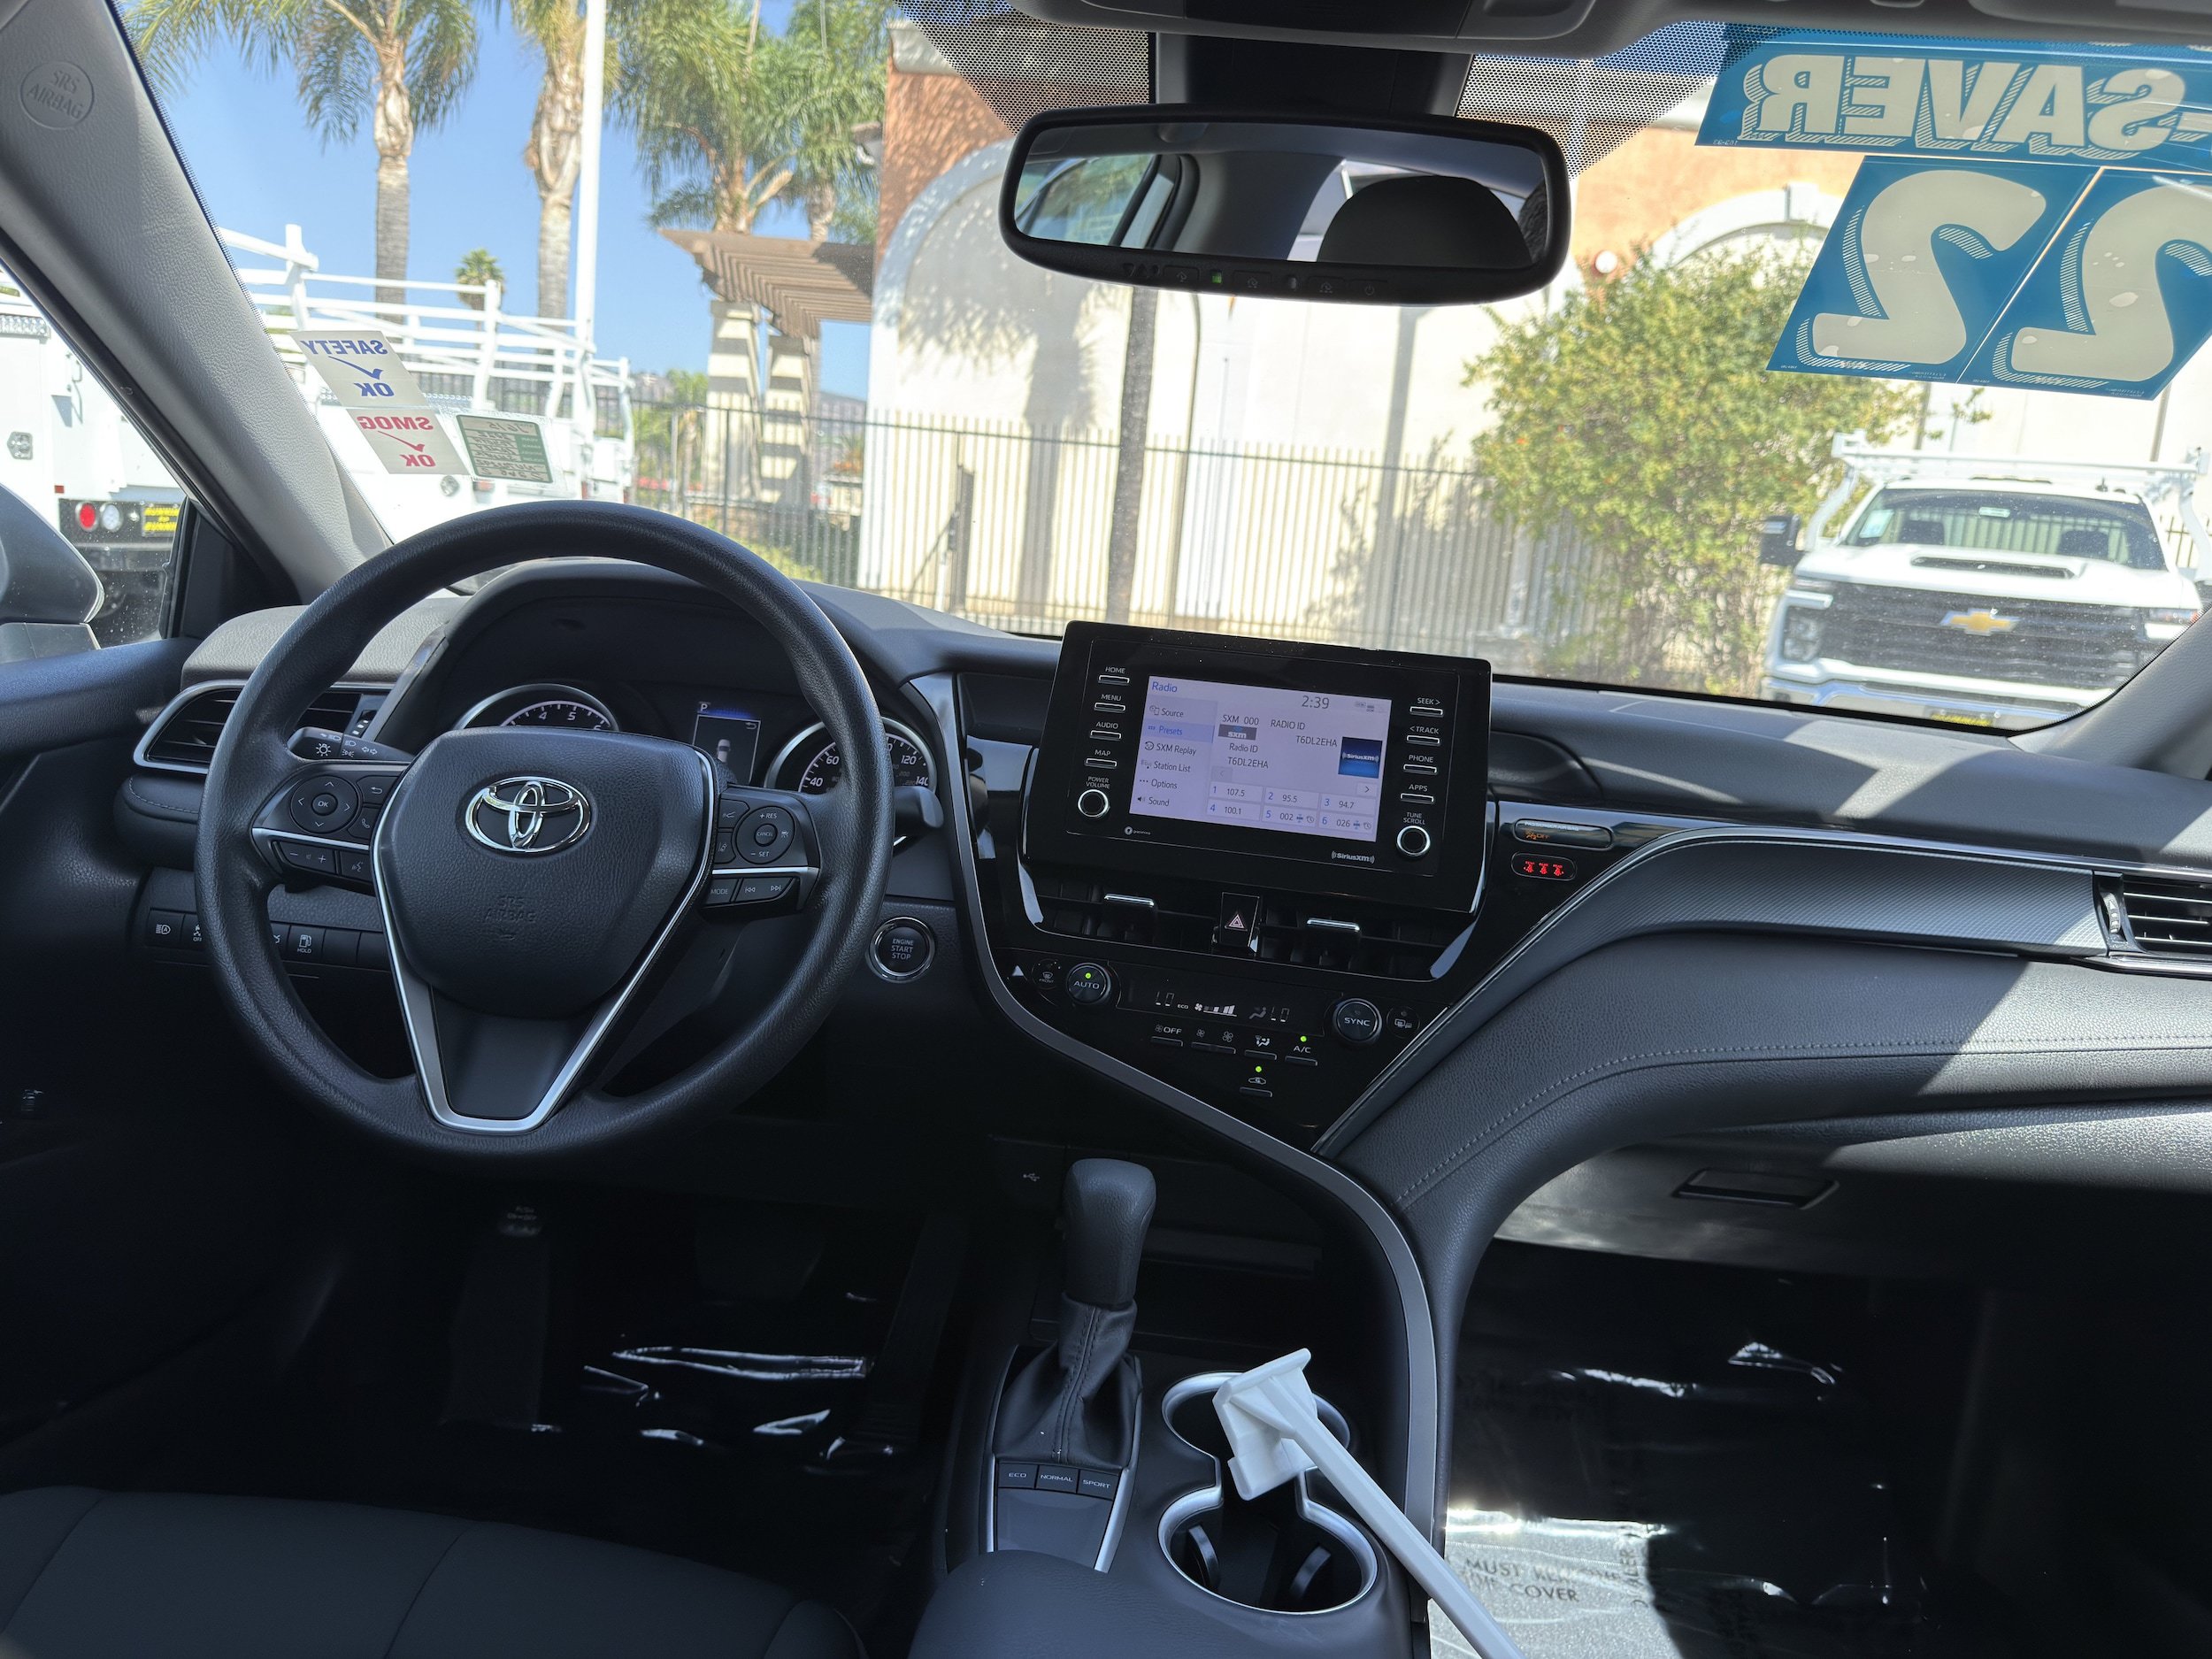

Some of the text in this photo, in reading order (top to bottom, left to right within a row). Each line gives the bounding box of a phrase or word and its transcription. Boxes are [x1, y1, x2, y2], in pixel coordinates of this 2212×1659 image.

[50, 70, 81, 94] SRS
[27, 83, 83, 119] AIRBAG
[1152, 681, 1178, 693] Radio
[1302, 695, 1330, 710] 2:39
[539, 711, 547, 720] 4
[567, 711, 577, 721] 5
[1161, 709, 1184, 718] Source
[1223, 714, 1260, 726] SXM 000
[1271, 719, 1306, 731] RADIO ID
[1159, 726, 1183, 735] Presets
[1416, 726, 1439, 734] TRACK
[1296, 735, 1337, 748] T6DL2EHA
[1156, 743, 1197, 757] SXM Replay
[1229, 743, 1248, 752] Radio
[826, 756, 840, 765] 60
[901, 755, 918, 765] 120
[1227, 757, 1269, 769] T6DL2EHA
[1154, 761, 1191, 772] Station List
[810, 777, 823, 787] 40
[1151, 779, 1178, 789] Options
[1226, 787, 1245, 796] 107.5
[1148, 797, 1170, 807] Sound
[1282, 794, 1298, 803] 95.5
[1225, 806, 1241, 815] 100.1
[1339, 801, 1355, 810] 94.7
[1279, 812, 1294, 821] 002
[1322, 816, 1328, 825] 6
[1073, 980, 1100, 989] AUTO
[1344, 1017, 1371, 1027] SYNC
[1163, 1026, 1182, 1035] OFF
[1293, 1045, 1311, 1054] A/C
[1082, 1479, 1110, 1489] SPORT
[1465, 1557, 1521, 1578] MUST
[1511, 1583, 1579, 1602] COVER
